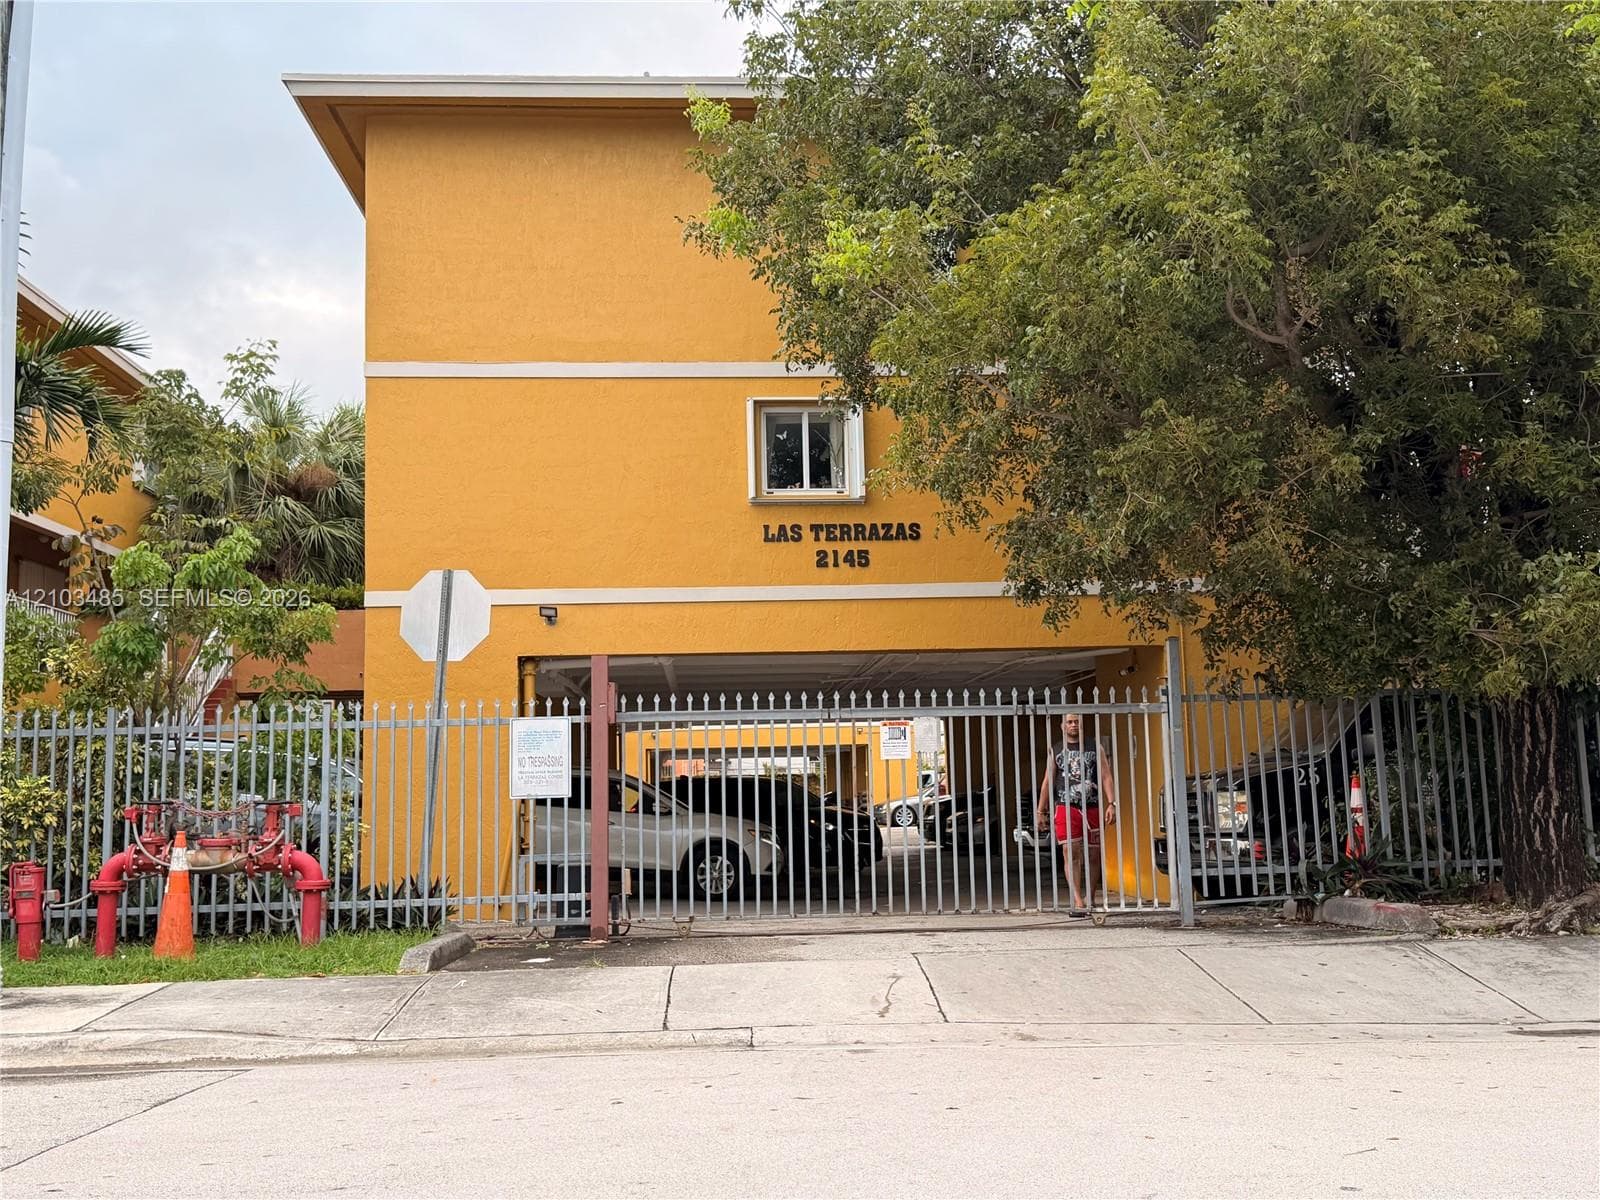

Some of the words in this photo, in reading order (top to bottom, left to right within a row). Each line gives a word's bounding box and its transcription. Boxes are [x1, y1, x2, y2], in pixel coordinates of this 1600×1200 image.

[763, 524, 803, 543] LAS
[810, 522, 922, 542] TERRAZAS
[816, 550, 870, 568] 2145
[518, 756, 526, 768] NO
[528, 755, 564, 768] TRESPASSING
